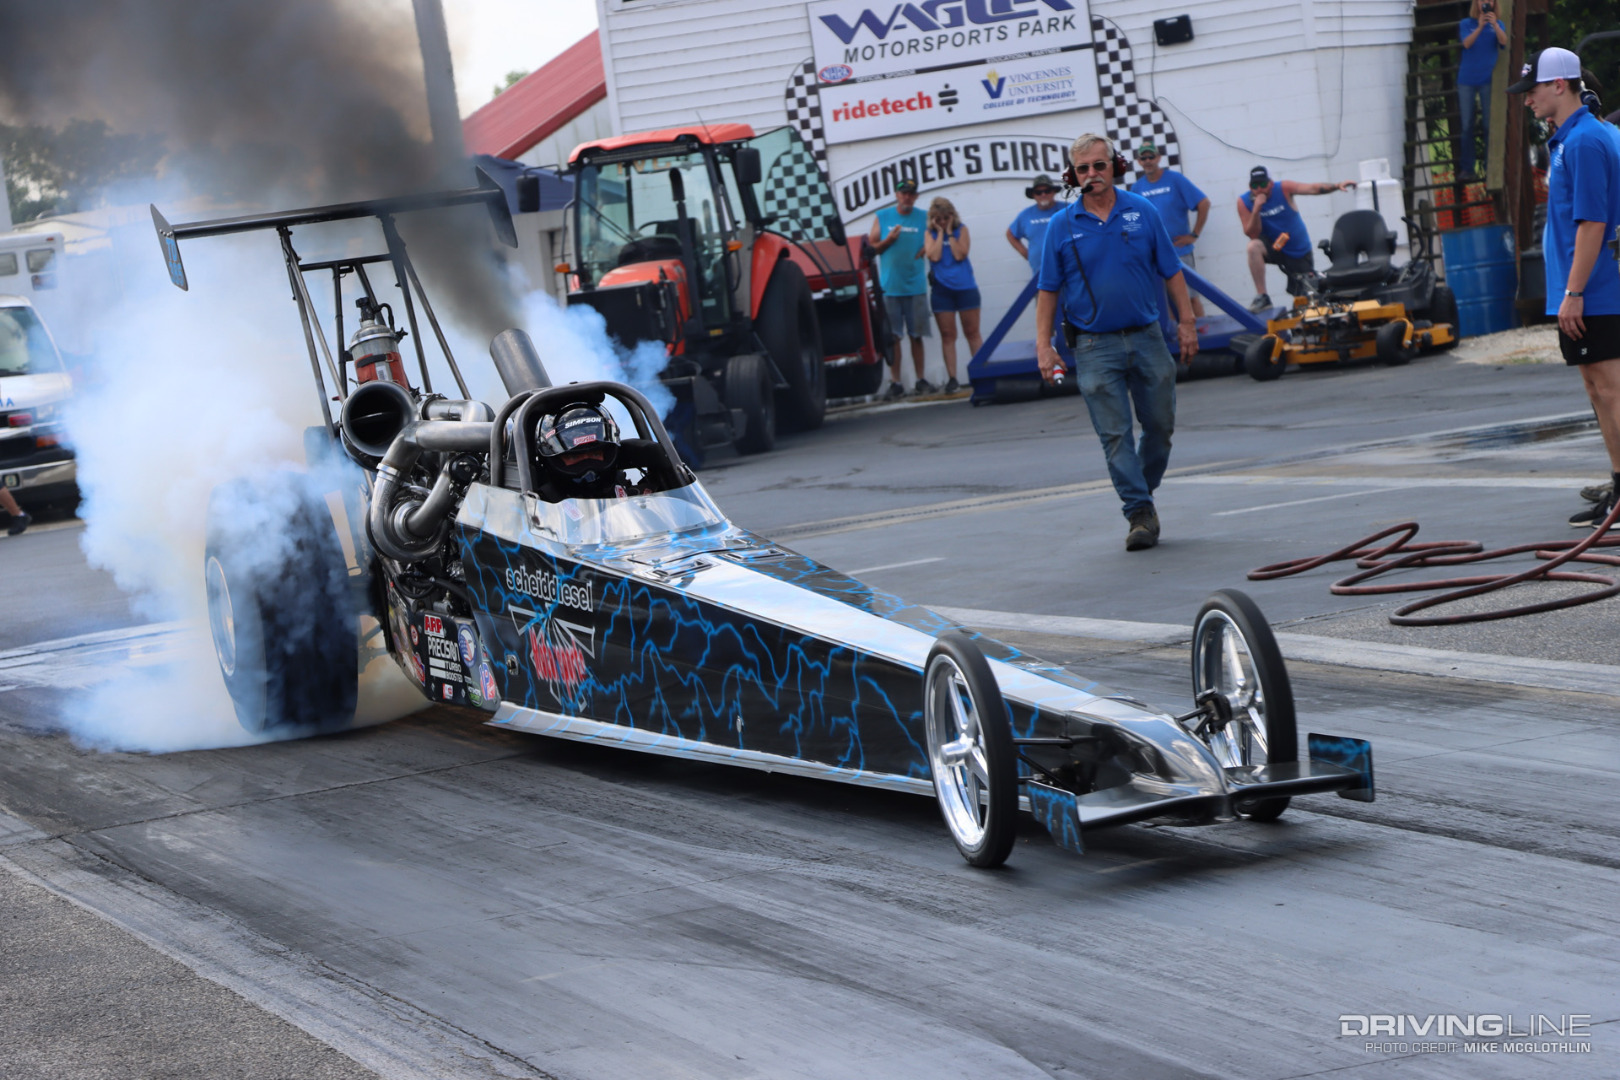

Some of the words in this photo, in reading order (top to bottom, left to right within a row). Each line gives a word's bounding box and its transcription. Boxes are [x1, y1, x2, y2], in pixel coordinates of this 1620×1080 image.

[819, 0, 1075, 45] WAGLE
[844, 22, 1008, 63] MOTORSPORTS
[1018, 14, 1077, 38] PARK
[1009, 66, 1072, 83] VINCENNES
[983, 99, 1014, 110] COLLEGE
[1027, 90, 1076, 103] TECHNOLOGY
[1009, 79, 1074, 97] UNIVERSITY
[833, 91, 933, 122] ridetech
[843, 143, 982, 212] WINNER'S
[565, 417, 602, 429] SIMPSON
